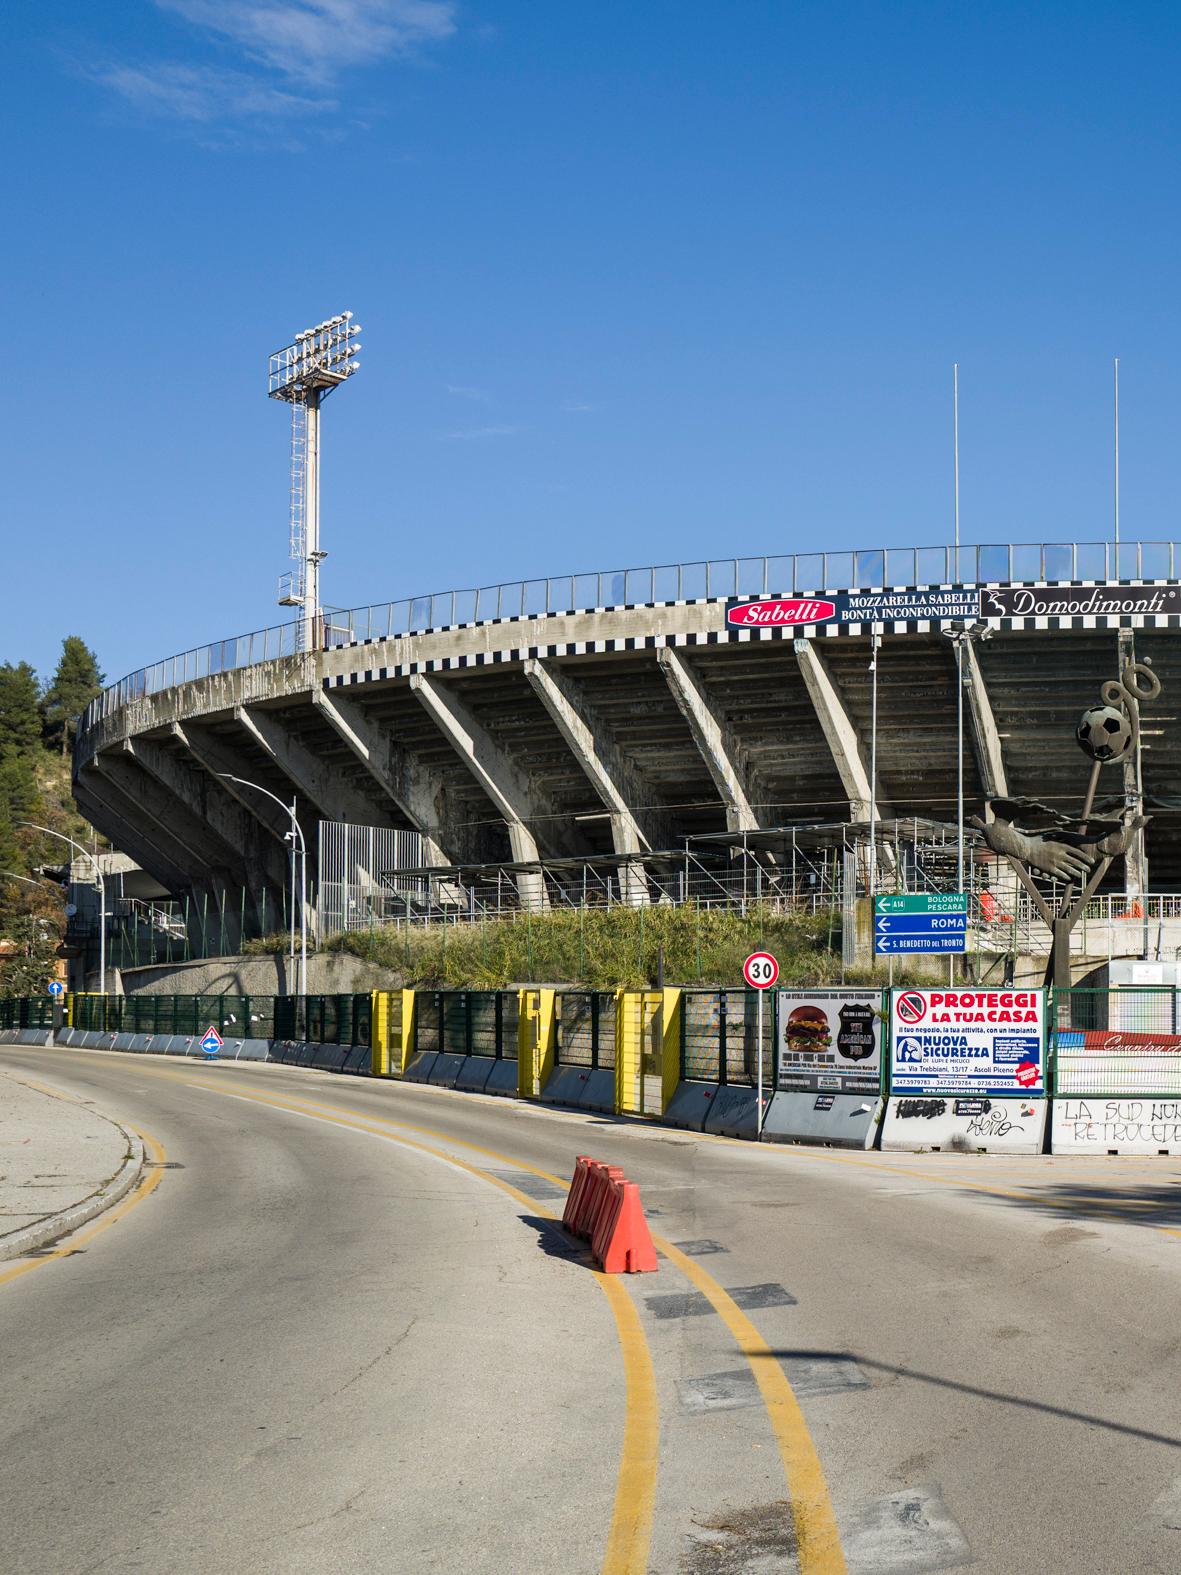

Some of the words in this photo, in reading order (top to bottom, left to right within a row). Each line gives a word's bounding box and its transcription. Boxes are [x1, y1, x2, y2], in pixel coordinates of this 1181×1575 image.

[849, 593, 927, 608] MOZZARELLA
[928, 592, 979, 604] SABELLI
[743, 602, 821, 623] Sabelli
[841, 606, 879, 621] BONTÀ
[881, 604, 979, 619] INCONFONDIBILE
[931, 918, 965, 928] ROMA
[893, 940, 898, 948] S.
[899, 939, 931, 948] BENEDETTO
[941, 938, 964, 947] TRONTO
[752, 963, 772, 979] 30
[930, 993, 1037, 1008] PROTEGGI
[932, 1012, 951, 1023] LA
[954, 1012, 985, 1023] TUA
[987, 1010, 1038, 1023] CASA
[1008, 1027, 1037, 1035] impianto
[923, 1035, 968, 1046] NUOVA
[923, 1047, 990, 1058] SICUREZZA
[1064, 1101, 1093, 1120] LA
[1105, 1102, 1143, 1122] SUD
